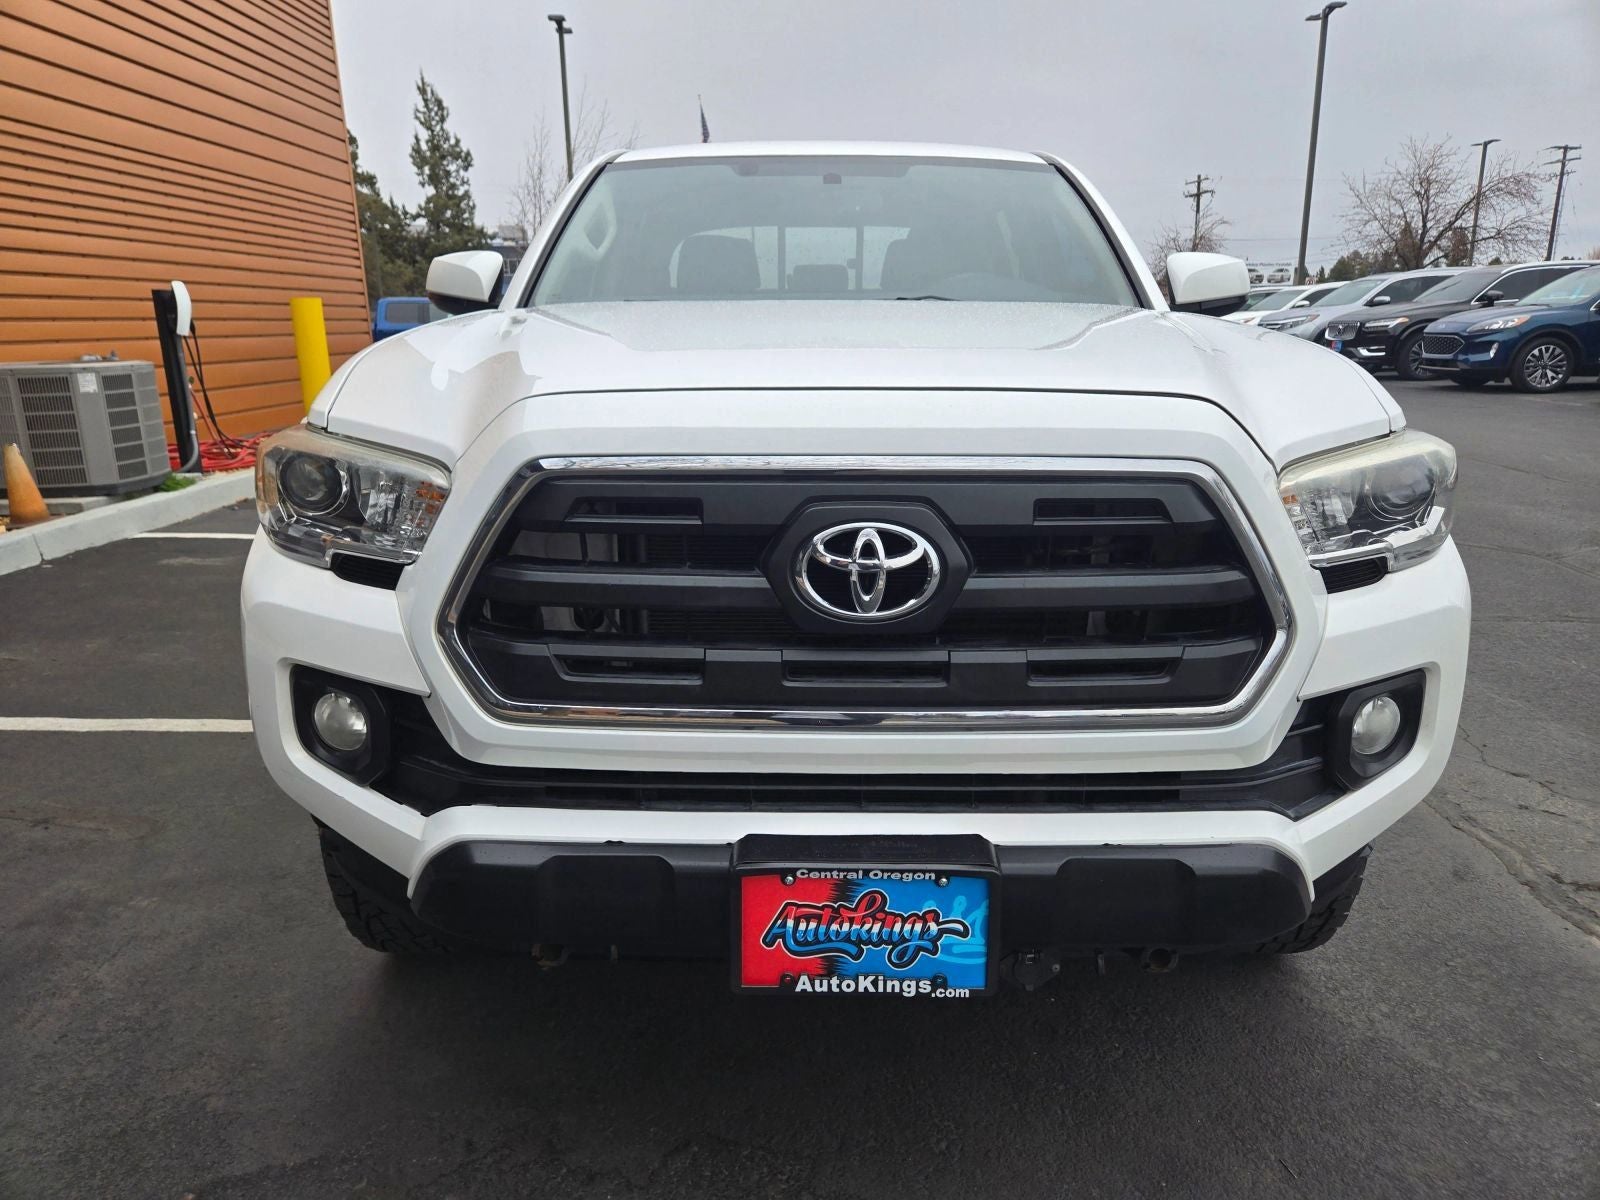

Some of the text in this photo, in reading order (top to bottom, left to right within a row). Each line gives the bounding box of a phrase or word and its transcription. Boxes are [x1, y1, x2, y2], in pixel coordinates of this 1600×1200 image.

[795, 869, 936, 881] Central Oregon
[795, 975, 970, 998] AutoKings.com
